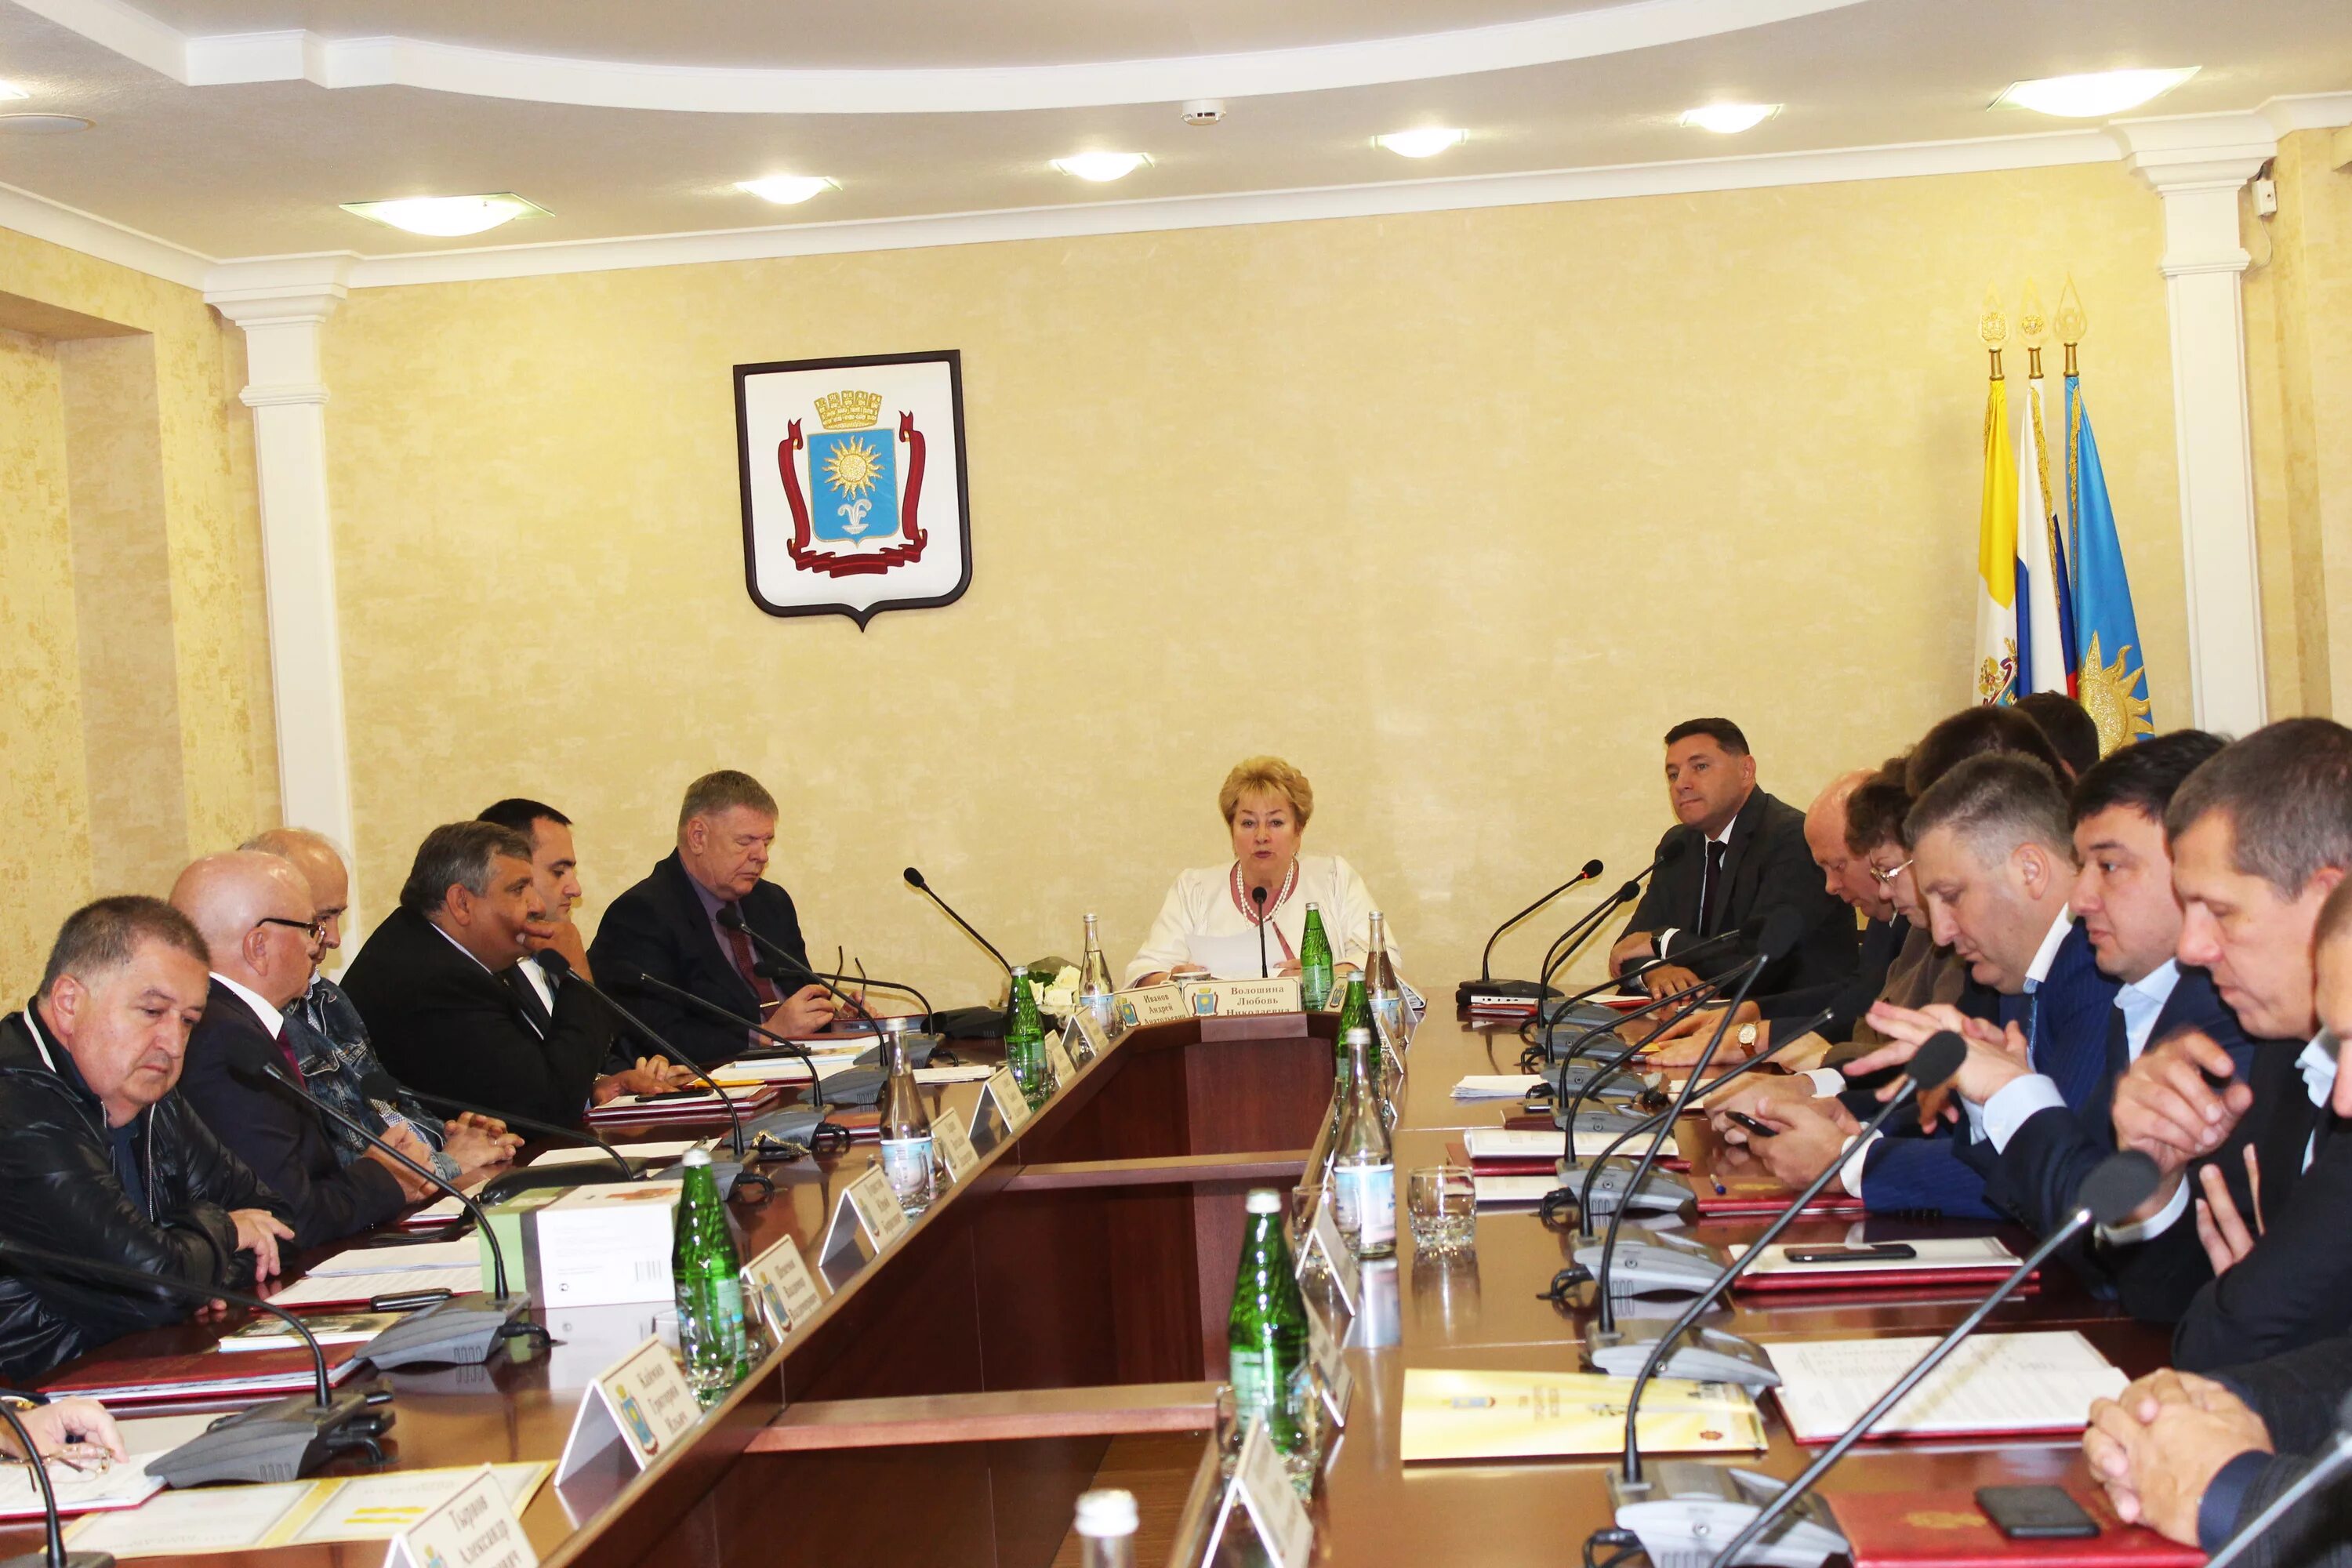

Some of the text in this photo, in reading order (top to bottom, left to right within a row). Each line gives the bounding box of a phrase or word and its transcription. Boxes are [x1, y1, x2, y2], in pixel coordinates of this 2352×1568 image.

[1231, 986, 1284, 995] Волошина
[1143, 994, 1170, 1004] Иванов
[1237, 996, 1279, 1006] Любовь
[1149, 1003, 1174, 1014] Андрей
